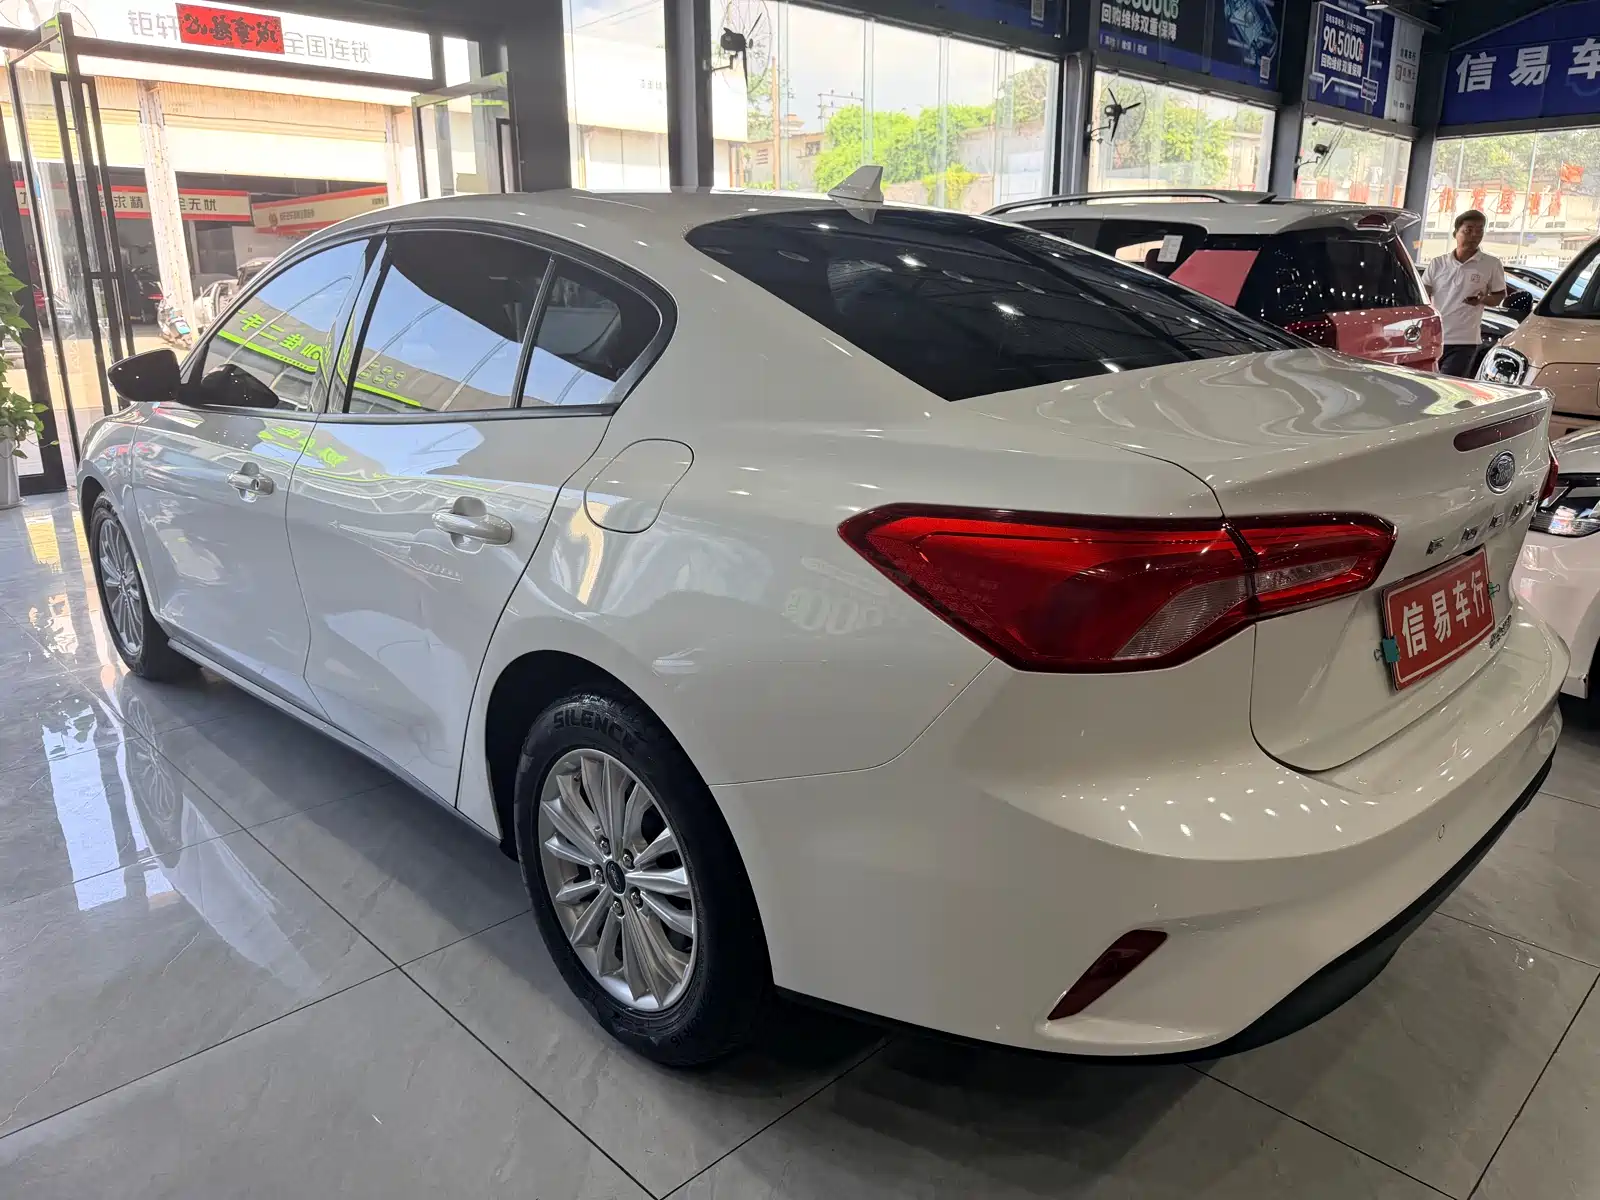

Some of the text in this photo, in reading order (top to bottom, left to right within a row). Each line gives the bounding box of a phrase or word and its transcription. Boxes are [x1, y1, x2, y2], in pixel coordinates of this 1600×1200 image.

[283, 31, 371, 64] 全国连锁
[1456, 38, 1600, 93] 信易车
[1401, 569, 1486, 659] 信易车行
